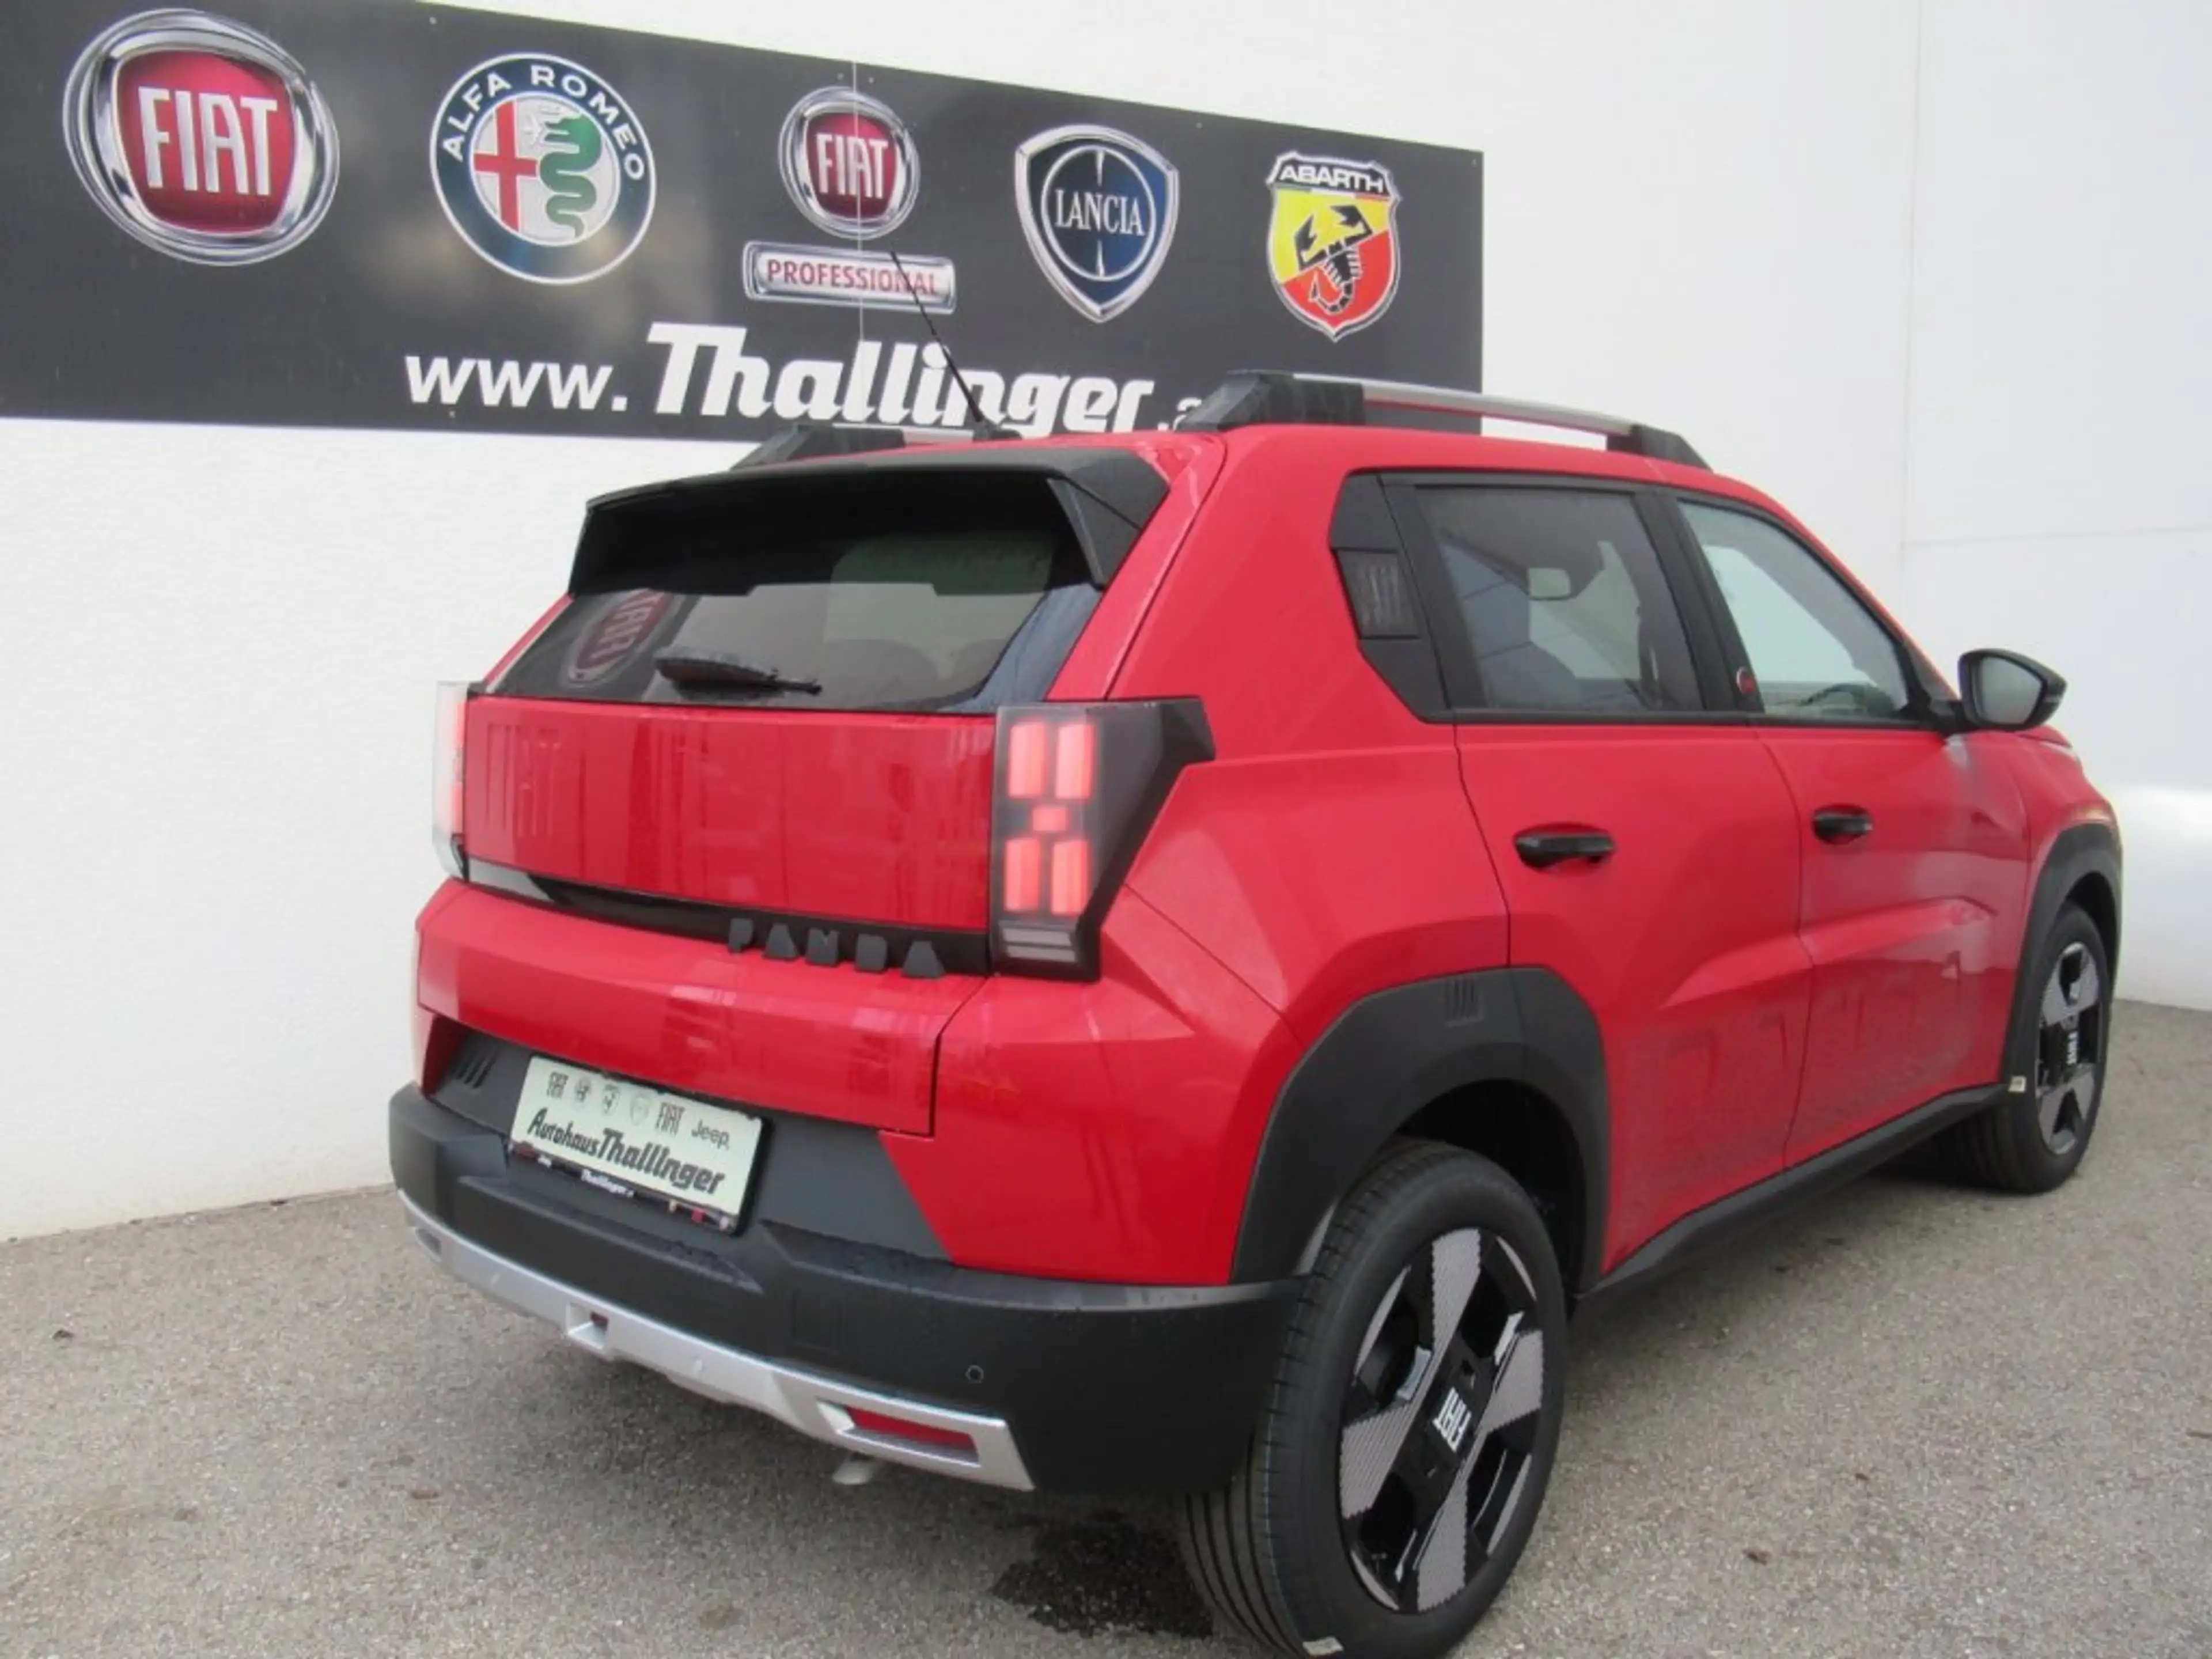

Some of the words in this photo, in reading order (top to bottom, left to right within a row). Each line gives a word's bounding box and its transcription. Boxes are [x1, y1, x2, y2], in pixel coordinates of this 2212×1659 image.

[138, 87, 277, 196] FIAT
[442, 72, 512, 161] ALFA
[531, 65, 644, 180] ROMEO
[815, 133, 889, 198] FIAT
[1280, 165, 1384, 192] ABARTH
[1054, 189, 1145, 236] LANCIA
[767, 259, 938, 295] PROFESSIONAL
[728, 918, 946, 980] PANDA
[691, 1120, 730, 1150] Jeep
